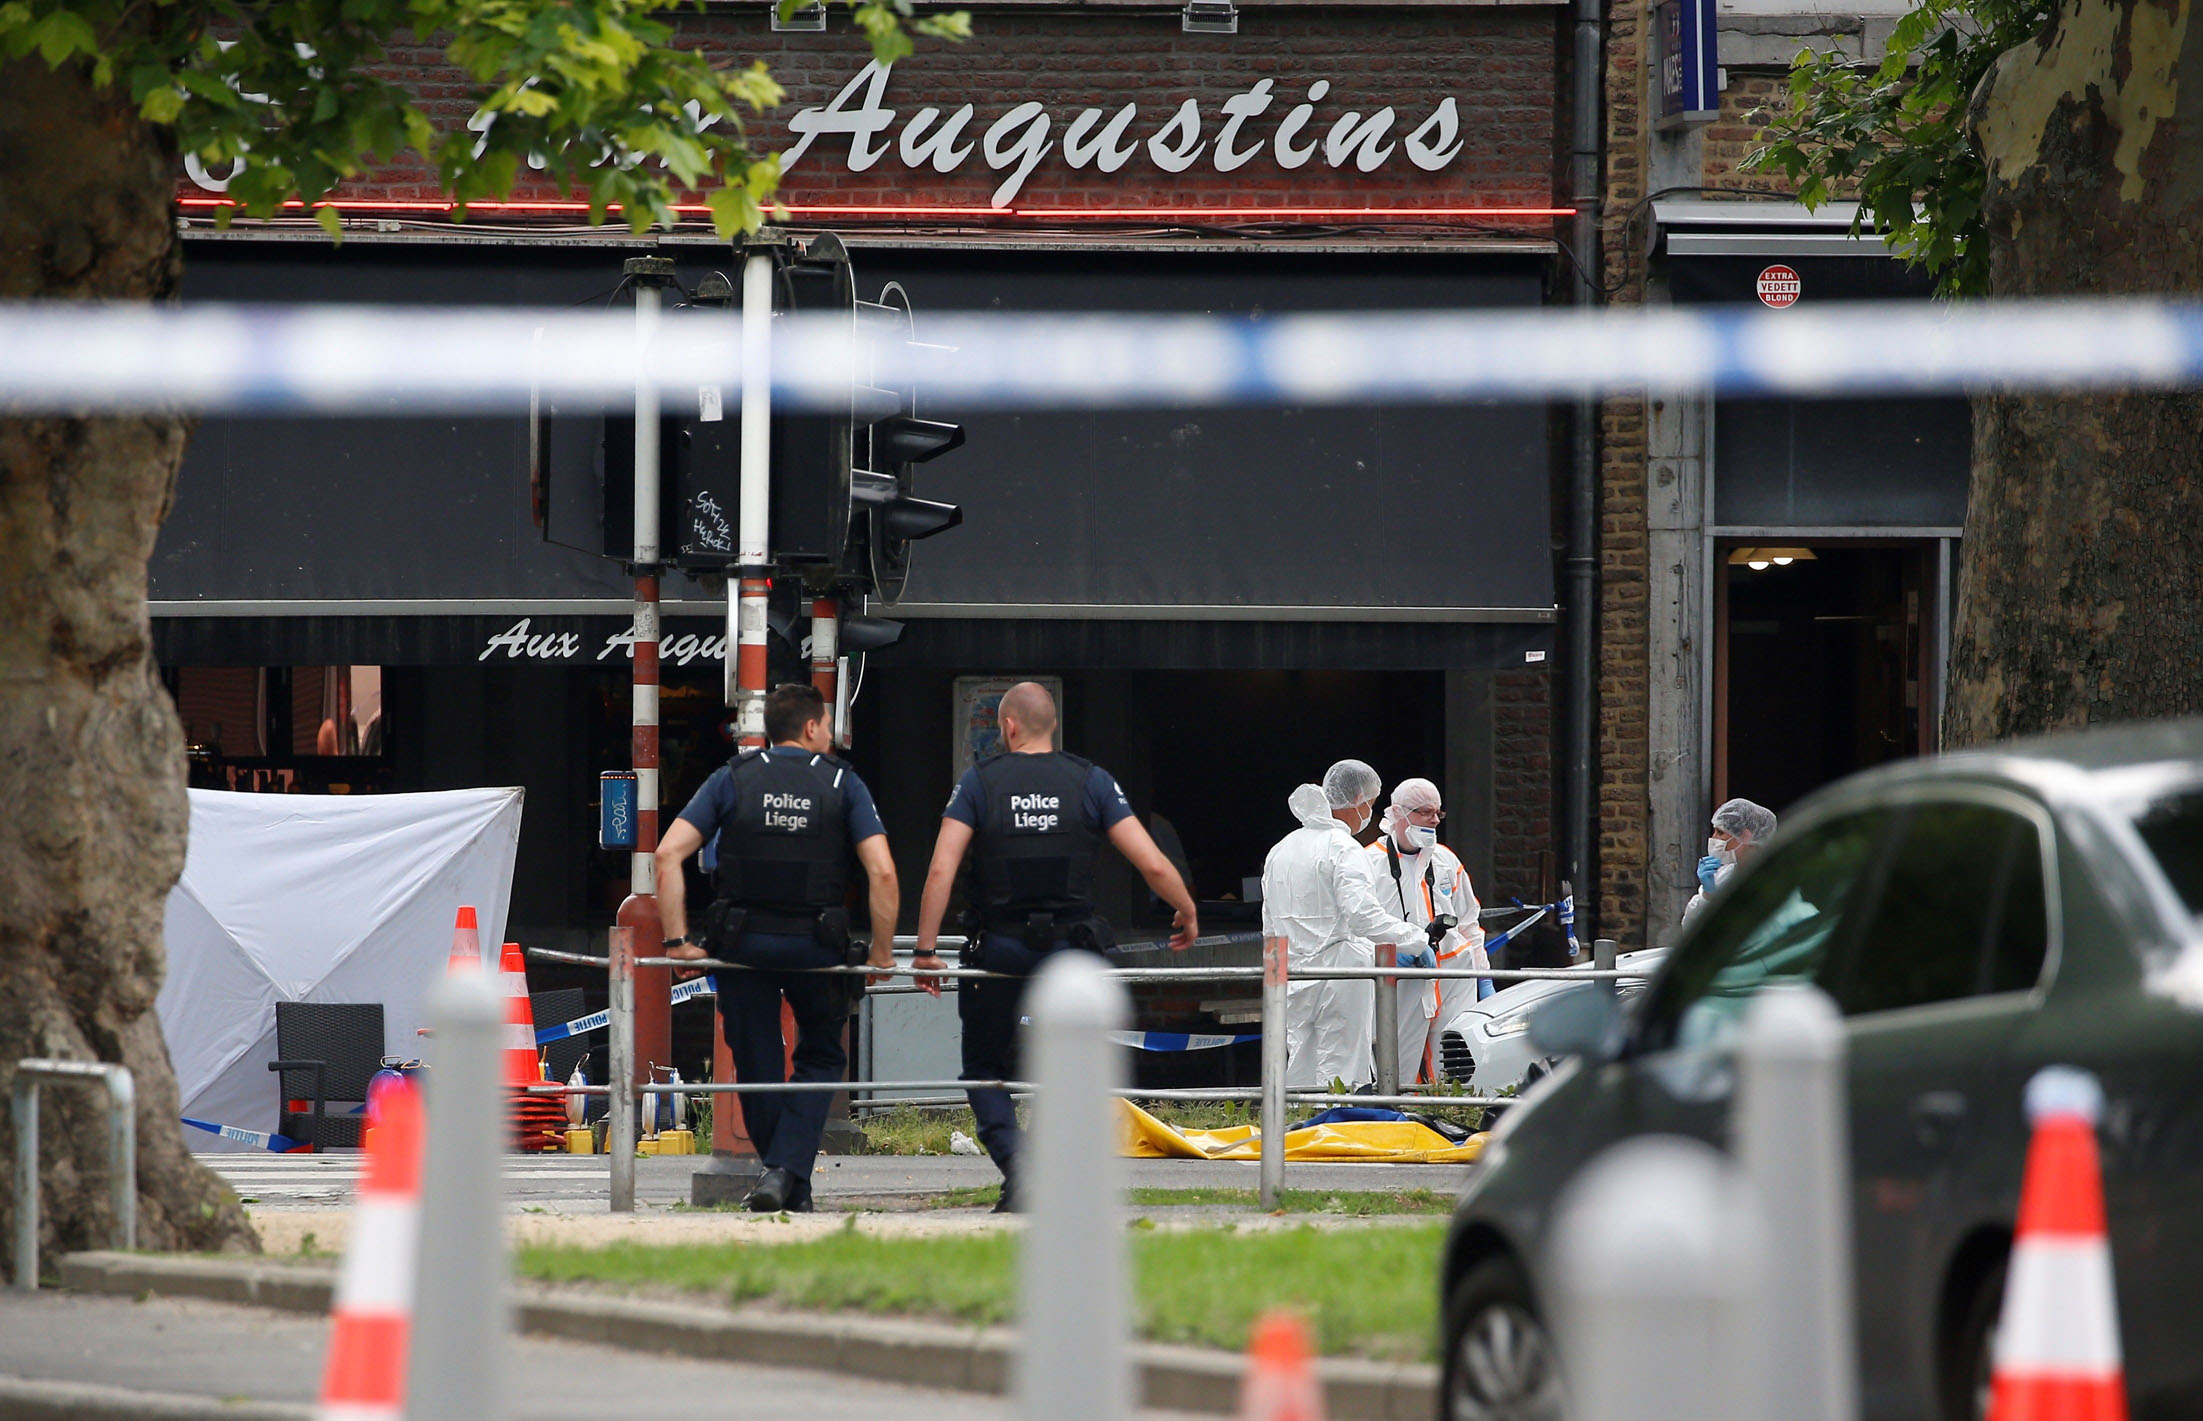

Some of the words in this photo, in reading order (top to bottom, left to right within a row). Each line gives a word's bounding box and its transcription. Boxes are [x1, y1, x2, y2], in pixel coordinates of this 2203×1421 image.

[776, 57, 1464, 209] Augustins
[1765, 272, 1794, 280] EXTRA
[1761, 282, 1798, 292] VEDETT
[1765, 294, 1794, 302] BLOND
[478, 617, 580, 661] Aux
[762, 793, 812, 810] Police
[1010, 793, 1060, 810] Police
[764, 811, 808, 831] Liege
[1014, 812, 1059, 831] Liege
[574, 1012, 608, 1032] POLITIE
